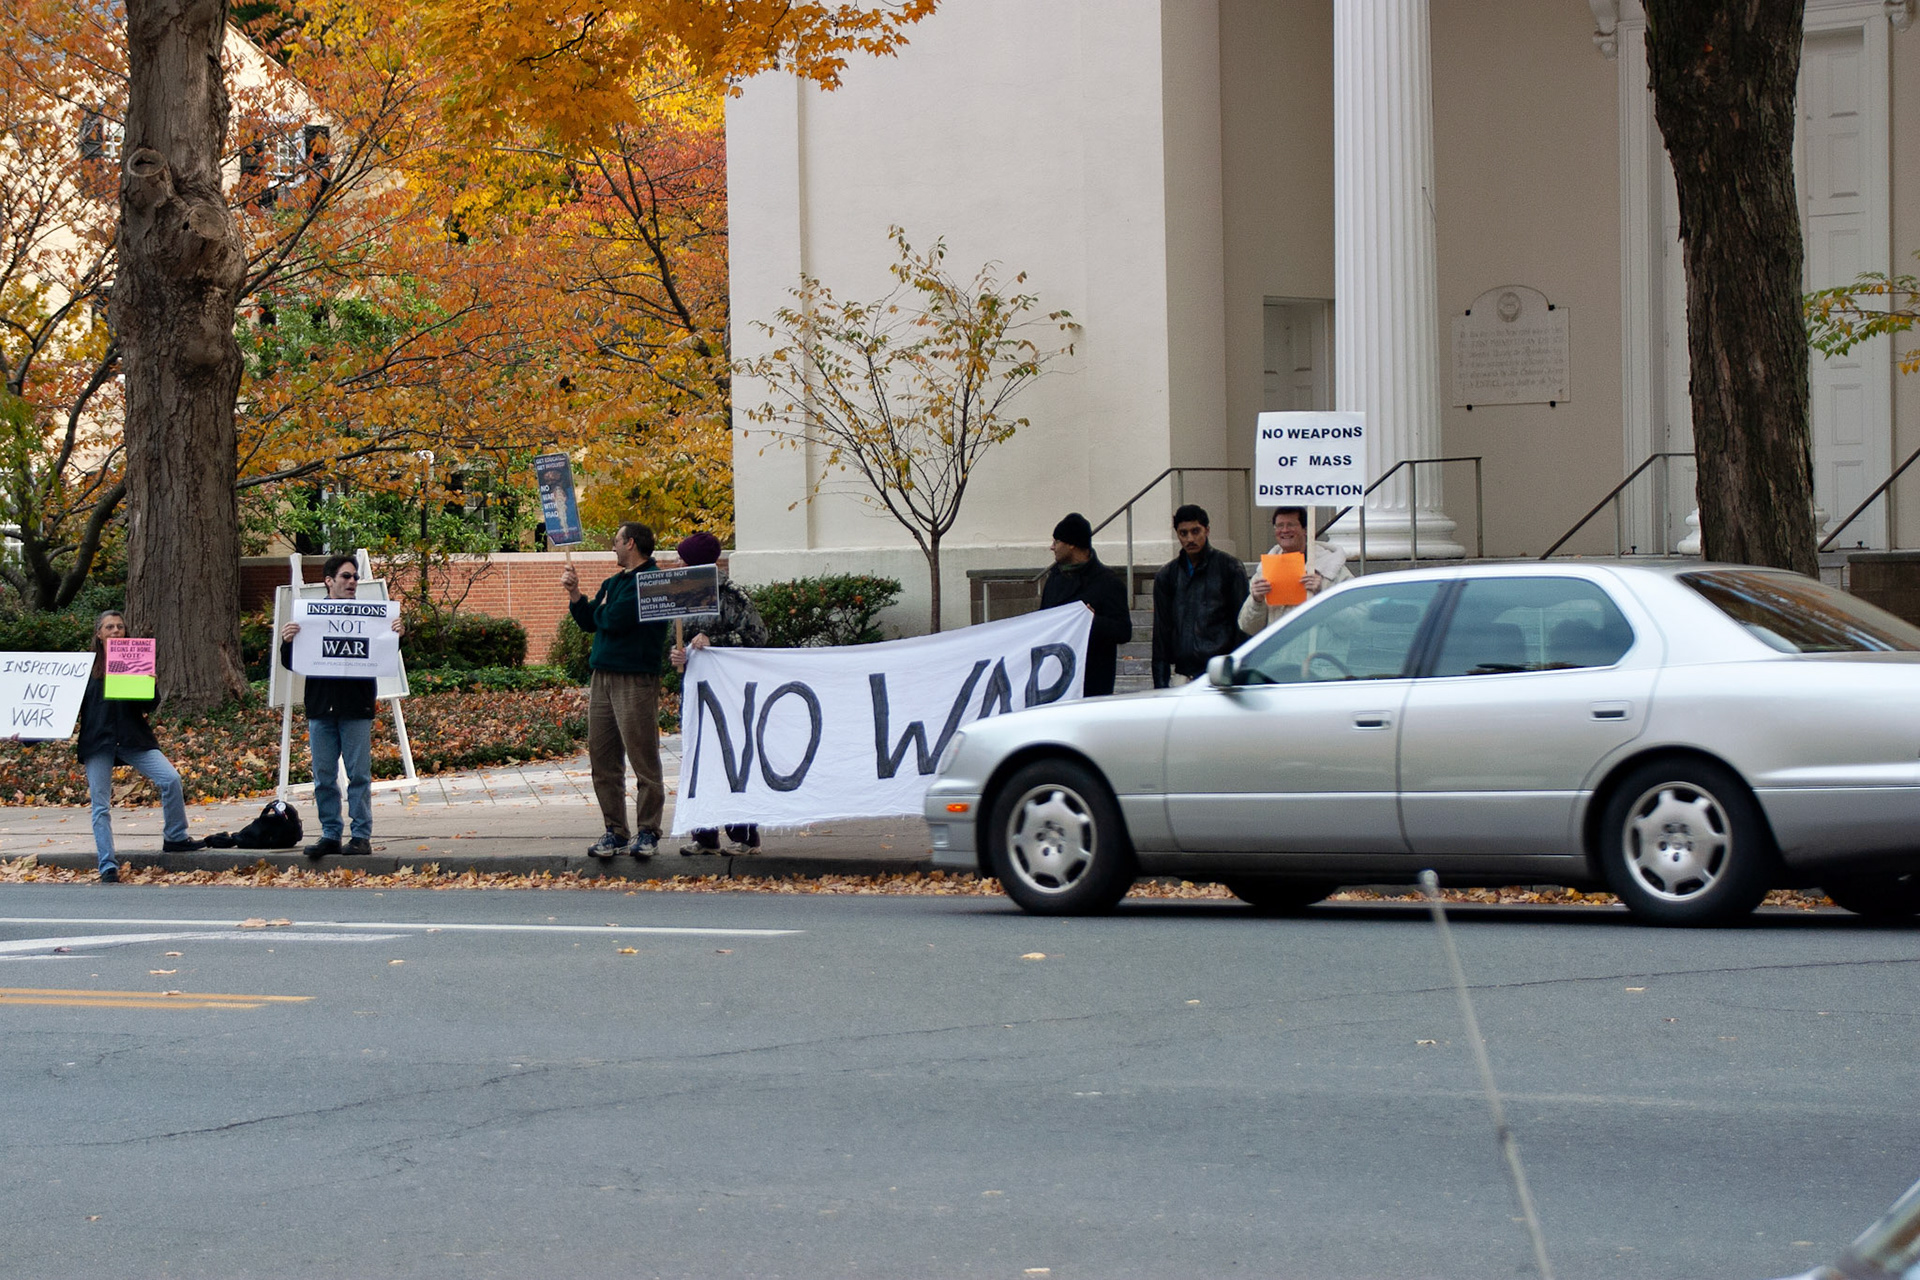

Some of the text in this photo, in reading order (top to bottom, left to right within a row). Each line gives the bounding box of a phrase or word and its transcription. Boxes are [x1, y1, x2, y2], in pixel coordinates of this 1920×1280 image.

[1262, 426, 1362, 439] NO WEAPONS
[1278, 455, 1352, 467] OF MASS
[1259, 485, 1362, 496] DISTRACTION
[542, 493, 555, 501] WAR
[543, 502, 557, 510] WITH
[545, 510, 559, 518] IRAQ
[640, 579, 671, 587] PACIFISM
[308, 604, 387, 616] INSPECTIONS
[641, 603, 658, 611] WITH
[328, 620, 366, 634] NOT
[324, 640, 366, 656] WAR
[3, 660, 88, 678] INSPECTIONS
[23, 683, 60, 702] NOT
[12, 707, 54, 728] WAR
[688, 680, 822, 799] NO
